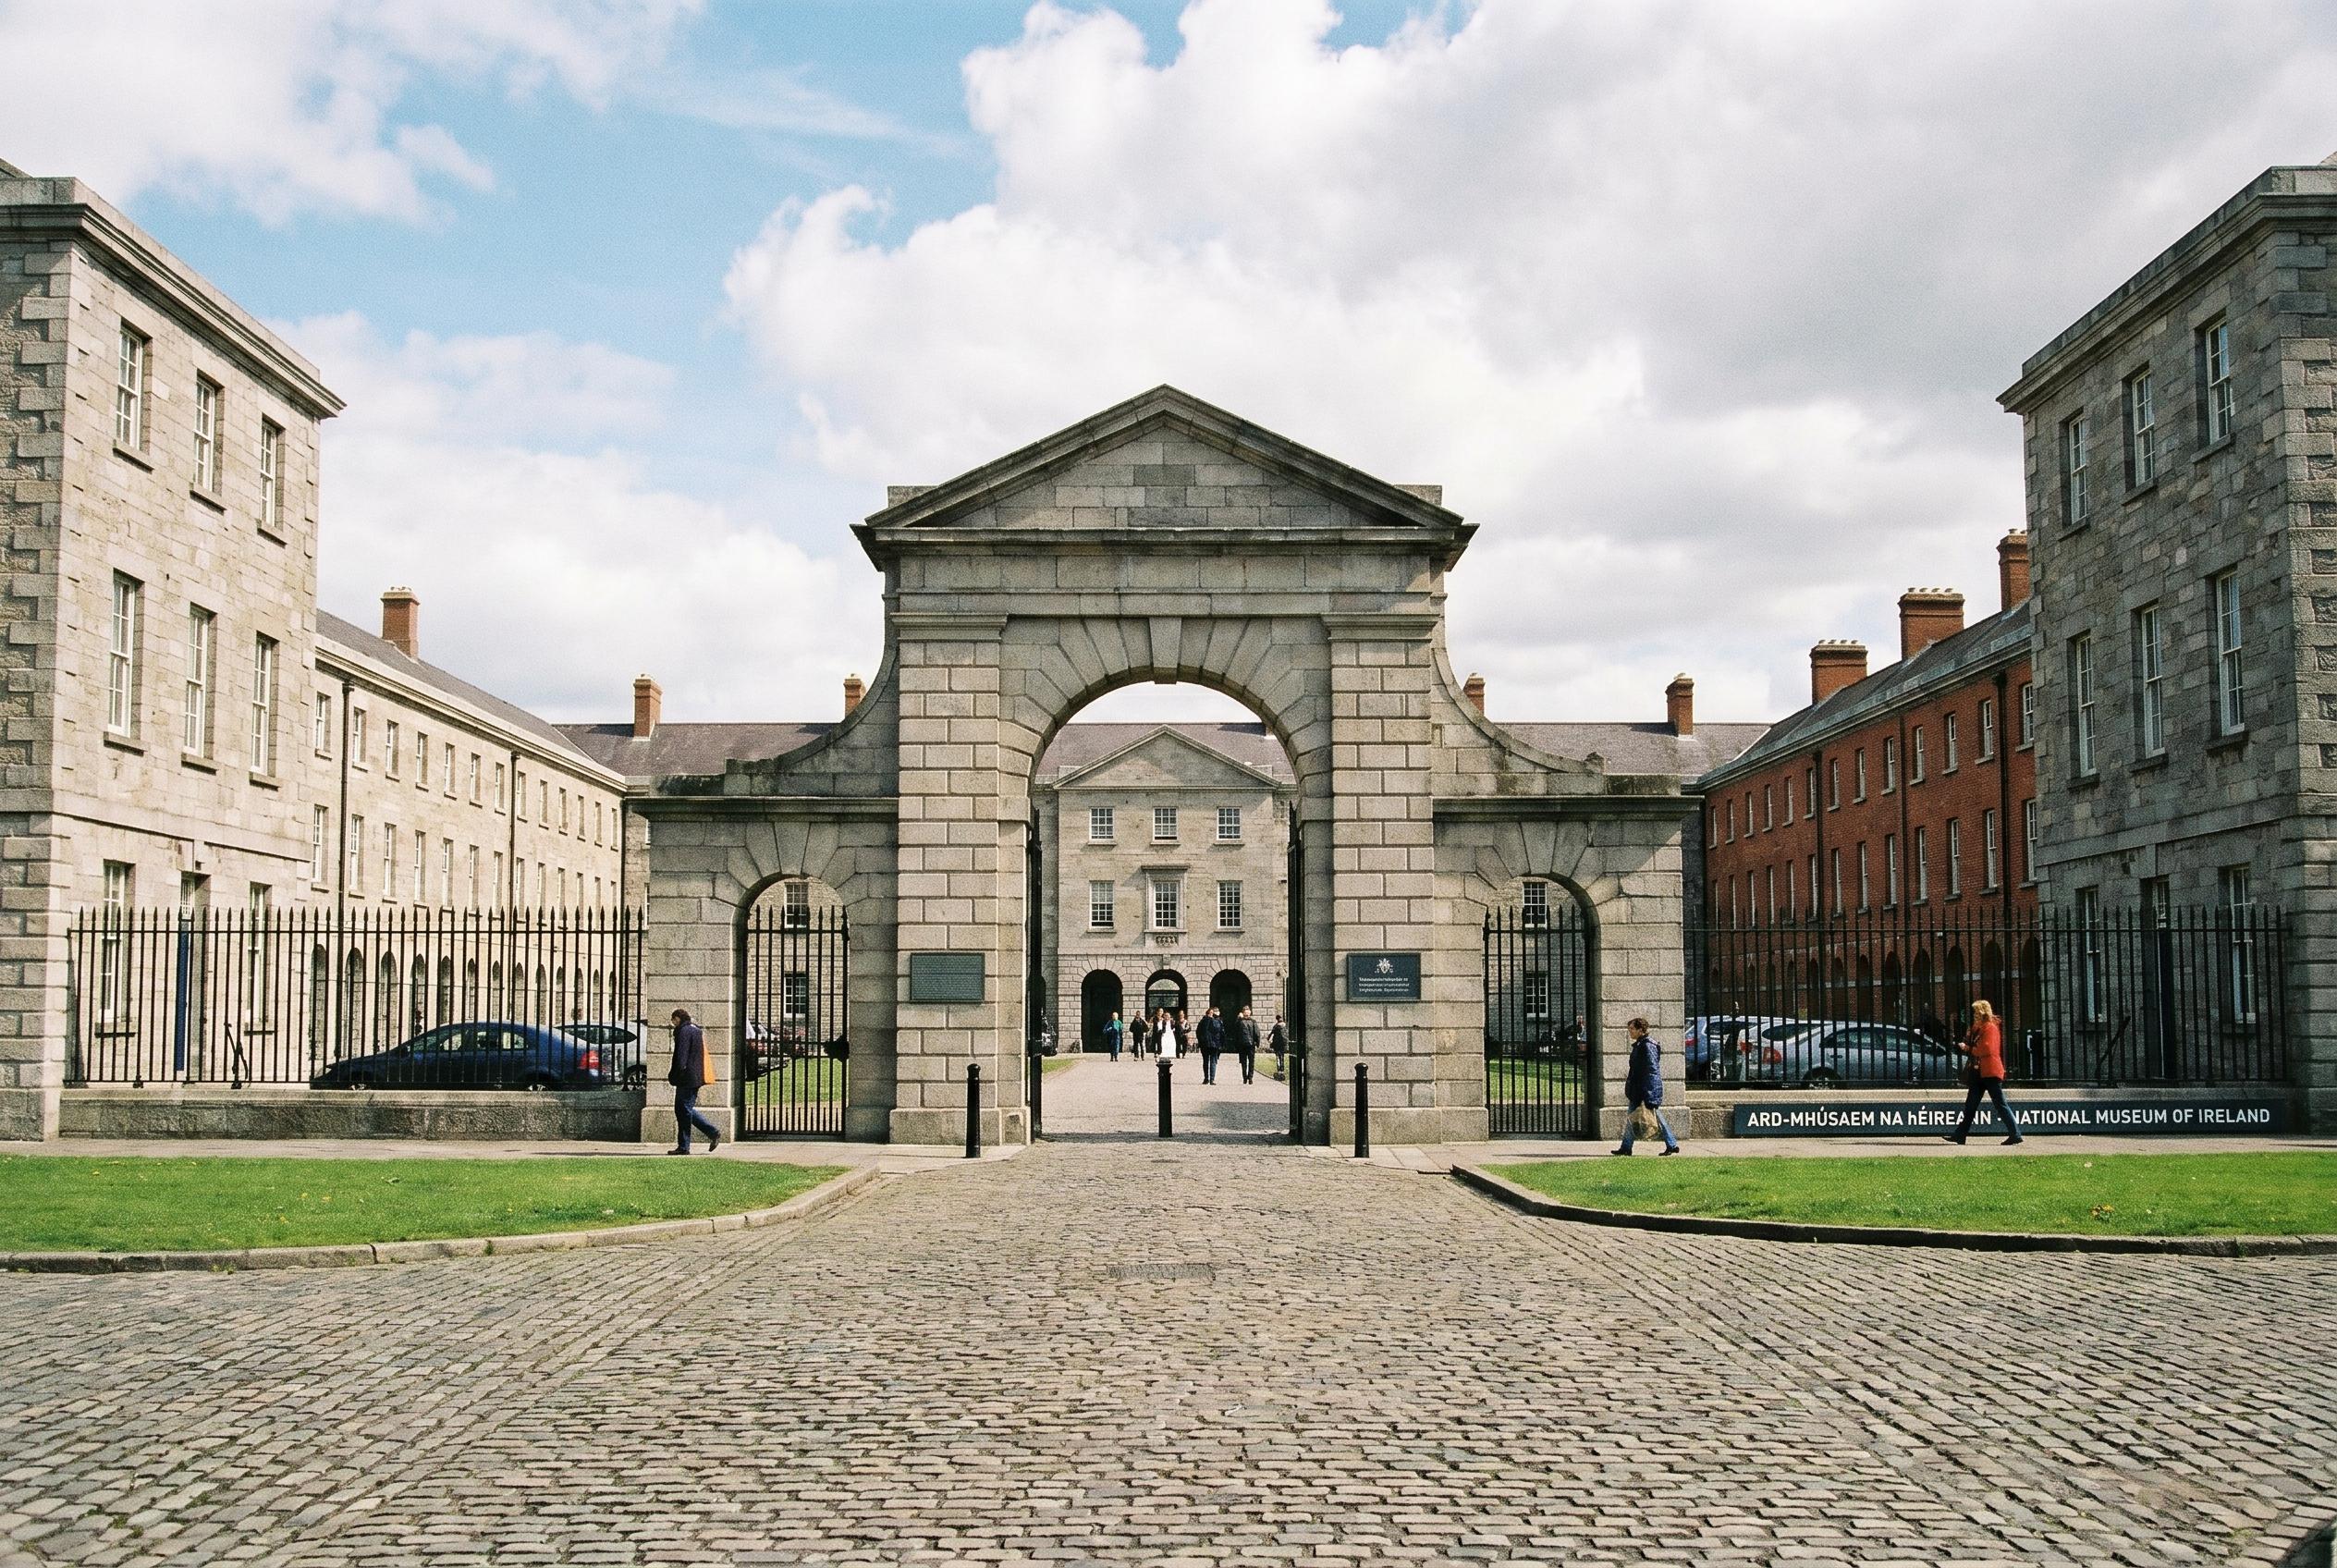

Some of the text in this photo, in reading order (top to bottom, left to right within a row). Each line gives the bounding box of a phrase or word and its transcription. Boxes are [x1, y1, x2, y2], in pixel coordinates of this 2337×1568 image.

[1746, 1106, 1875, 1127] ARD-MHÚSAEM
[1879, 1110, 1904, 1126] NA
[2096, 1109, 2167, 1124] MUSEUM
[2172, 1109, 2194, 1123] OF
[2198, 1109, 2270, 1123] IRELAND
